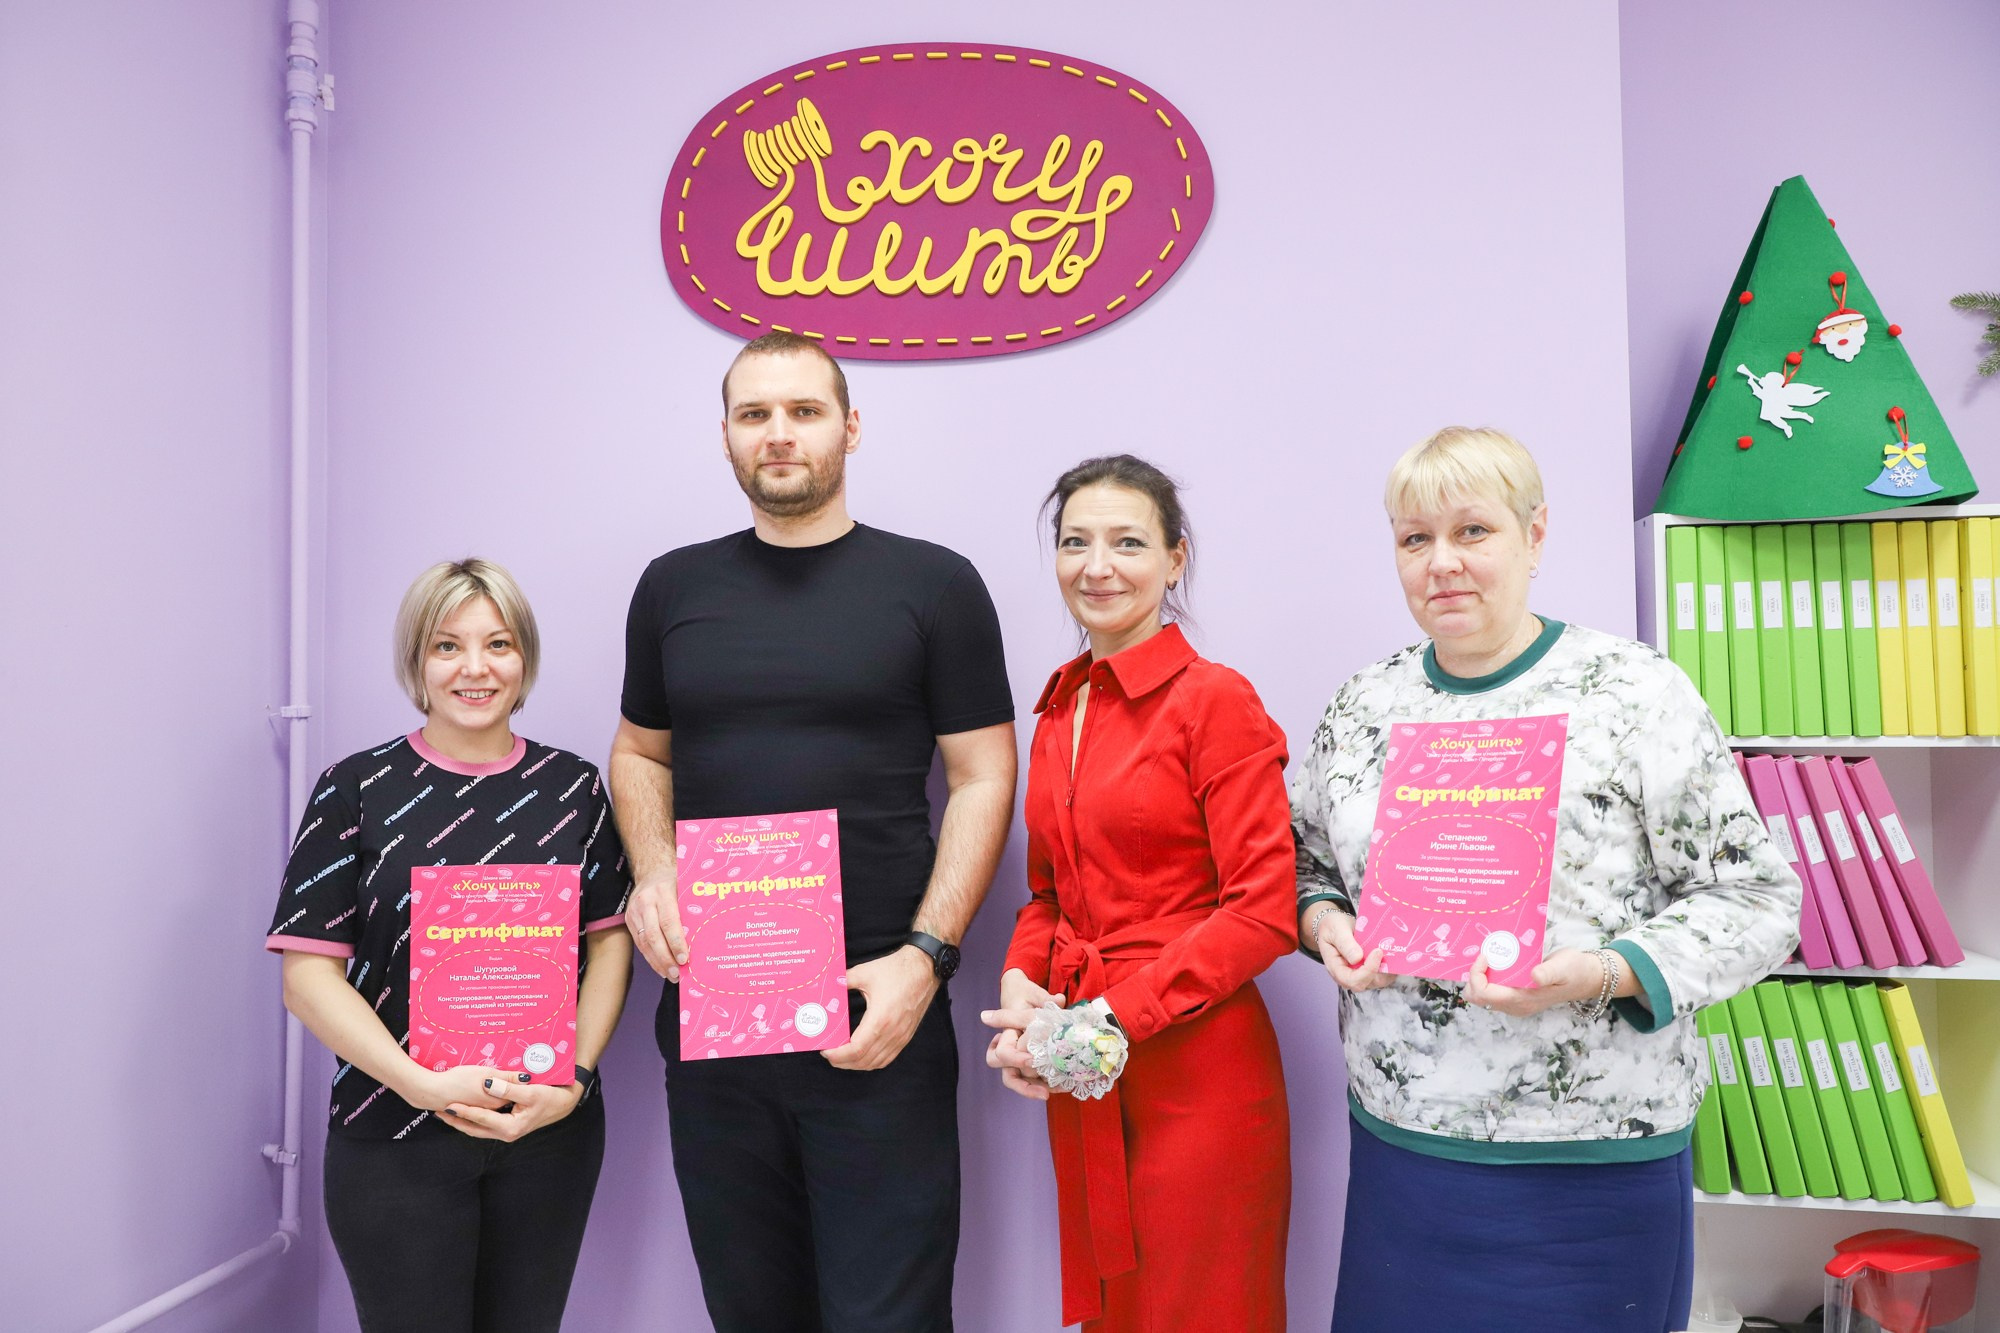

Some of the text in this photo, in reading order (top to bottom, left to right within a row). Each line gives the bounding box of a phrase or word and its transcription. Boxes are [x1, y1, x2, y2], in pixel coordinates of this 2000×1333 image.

[1430, 737, 1523, 750] «Хочу шить»
[376, 765, 392, 777] KARL
[413, 762, 429, 777] KARL
[417, 785, 433, 799] KARL
[455, 785, 471, 798] KARL
[1395, 785, 1545, 807] Сертификат
[458, 808, 475, 821] KARL
[496, 811, 511, 823] KARL
[499, 833, 515, 846] KARL
[537, 834, 552, 846] KARL
[715, 831, 800, 844] «Хочу шить»
[1438, 833, 1487, 842] Степаненко
[1430, 842, 1495, 851] Ирине Львовне
[295, 854, 355, 895] KARL LAGERFELD
[1396, 864, 1456, 874] Конструирование,
[1458, 868, 1513, 876] моделирование
[453, 880, 540, 891] «Хочу шить»
[1430, 875, 1458, 883] изделий
[692, 874, 826, 900] Сертификат
[288, 908, 306, 924] KARL
[326, 915, 344, 929] KARL
[746, 921, 777, 929] Волкову
[426, 923, 565, 943] Сертификат
[725, 928, 800, 940] Дмитрию Юрьевичу
[707, 953, 761, 962] Конструирование,
[763, 949, 810, 958] моделирование
[474, 965, 517, 974] Шугуровой
[739, 960, 765, 968] изделий
[482, 973, 540, 981] Александровне
[410, 1109, 429, 1127] KARL
